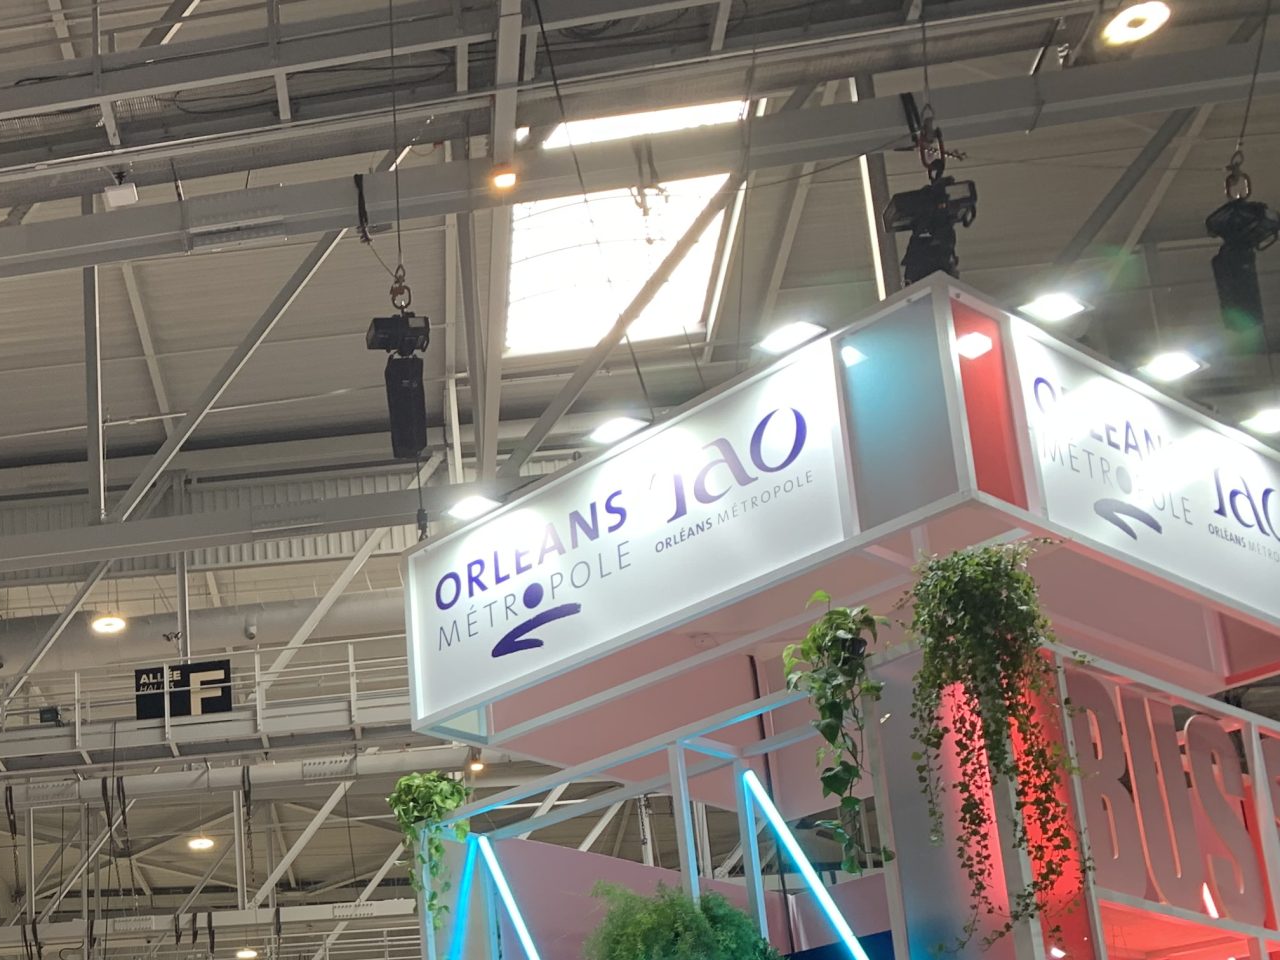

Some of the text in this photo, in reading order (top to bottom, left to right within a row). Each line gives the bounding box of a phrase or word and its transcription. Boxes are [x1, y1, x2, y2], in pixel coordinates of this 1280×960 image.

[654, 470, 814, 553] ORLÉANS MÉTROPOLE
[190, 669, 225, 716] F
